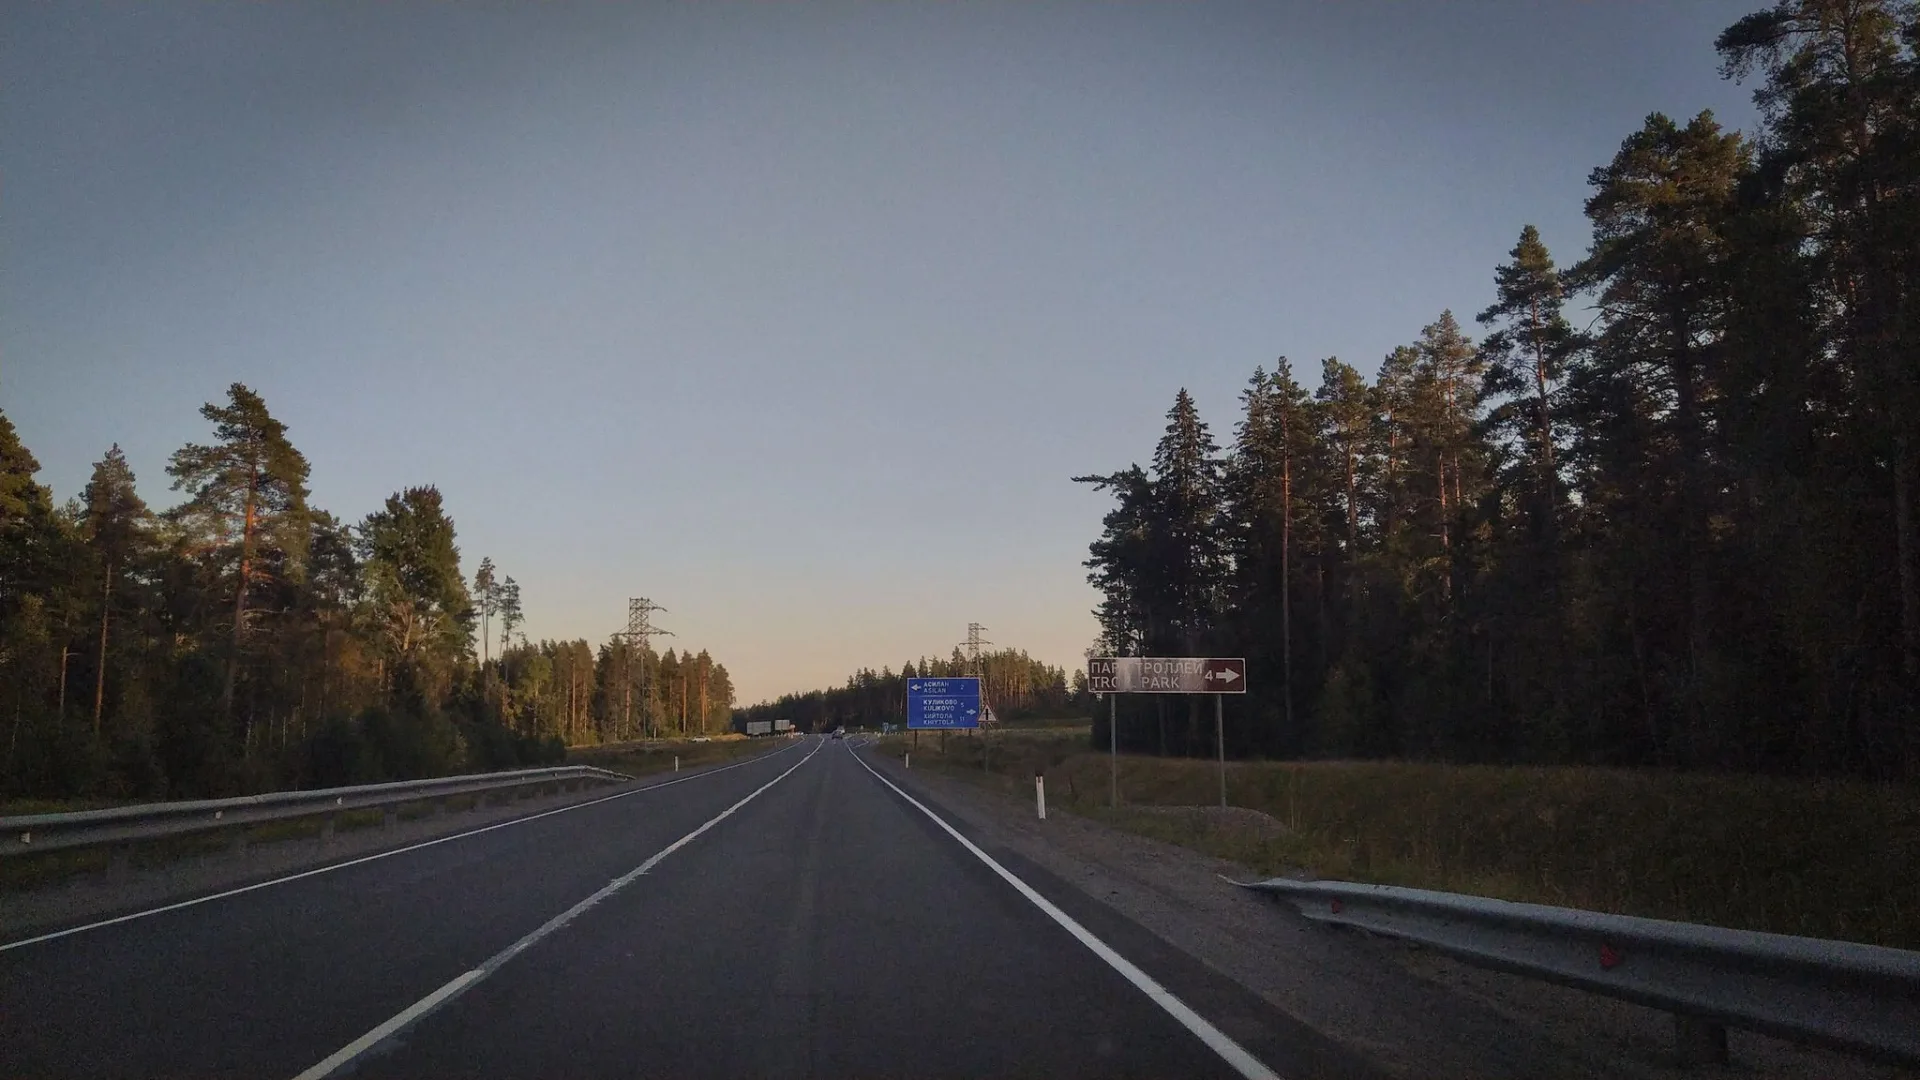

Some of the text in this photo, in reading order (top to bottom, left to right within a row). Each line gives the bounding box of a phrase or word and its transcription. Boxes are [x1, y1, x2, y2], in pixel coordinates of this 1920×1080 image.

[1091, 660, 1203, 674] ПАР ТРОЛЛЕЙ
[1141, 676, 1180, 689] PARK
[1204, 670, 1214, 682] 4
